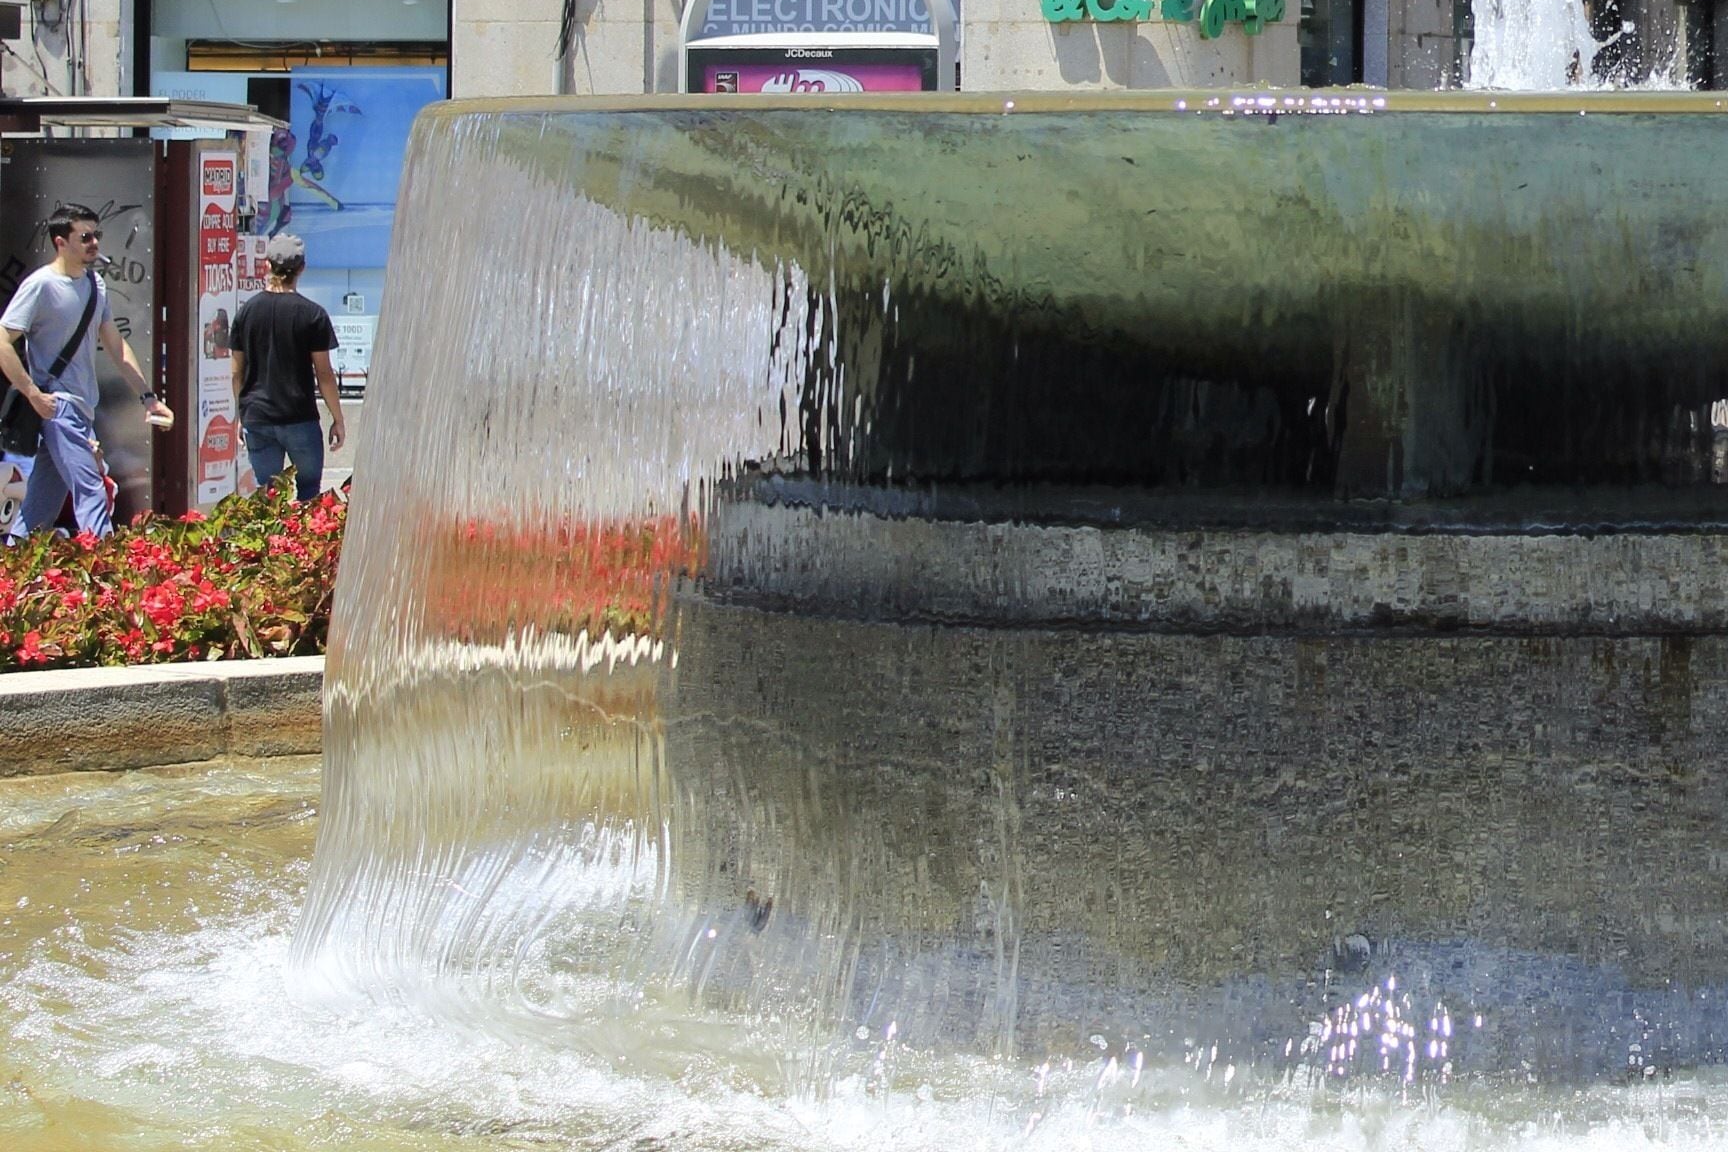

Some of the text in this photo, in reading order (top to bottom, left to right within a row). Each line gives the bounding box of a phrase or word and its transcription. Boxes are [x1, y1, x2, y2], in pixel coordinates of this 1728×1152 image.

[785, 48, 833, 59] JCDecaux
[171, 89, 207, 99] PODER
[204, 167, 232, 185] MADRID
[203, 214, 222, 229] COMPRE
[207, 237, 231, 253] BUY HERE
[204, 263, 234, 293] TICKETS
